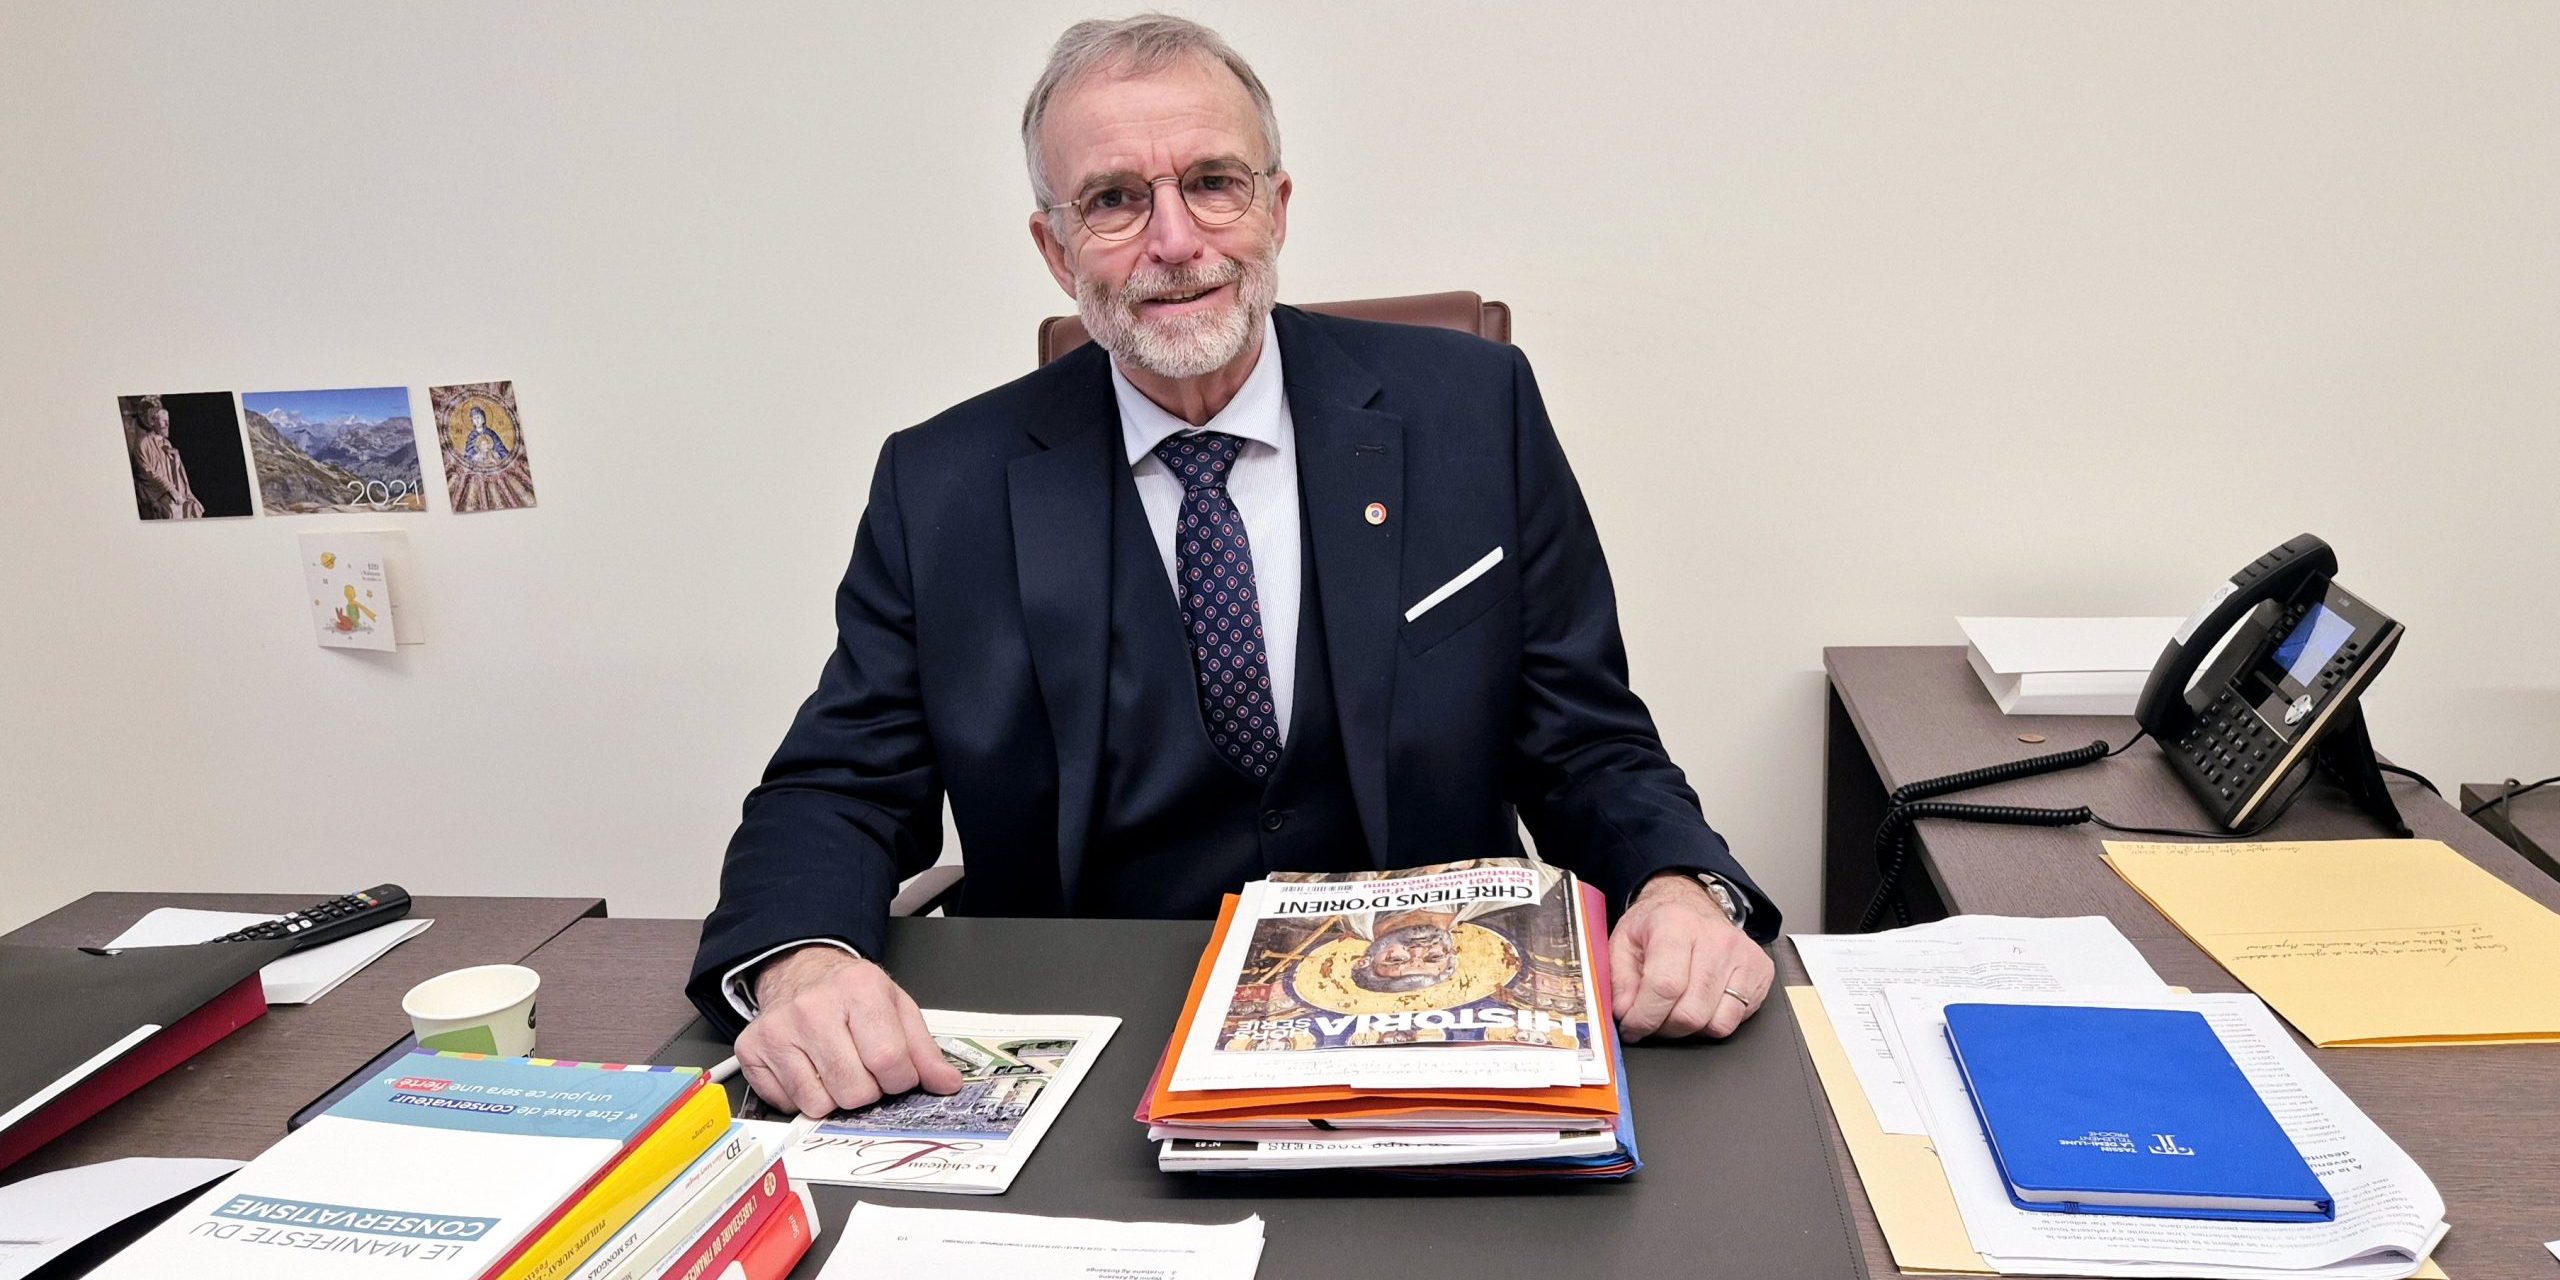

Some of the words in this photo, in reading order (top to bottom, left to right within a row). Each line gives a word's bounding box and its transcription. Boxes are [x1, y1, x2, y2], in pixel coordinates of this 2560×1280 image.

[347, 479, 421, 508] 2021
[1362, 876, 1431, 890] méconnu
[1434, 869, 1534, 884] christianisme
[1508, 875, 1534, 887] Les
[1372, 886, 1405, 896] d'un
[1407, 878, 1463, 892] visages
[1396, 884, 1534, 908] CHRÉTIENS
[1273, 896, 1390, 915] D'ORIENT
[1314, 1008, 1577, 1037] HISTORIA
[399, 1077, 448, 1093] fierté
[447, 1082, 485, 1094] une
[486, 1086, 524, 1098] sera
[524, 1090, 548, 1100] ce
[548, 1090, 589, 1103] jour
[586, 1093, 613, 1104] un
[393, 1093, 515, 1114] conservateur.
[516, 1105, 542, 1117] de
[542, 1107, 582, 1119] taxé
[585, 1109, 624, 1123] Être
[2078, 1135, 2132, 1143] TELLEMENT
[2087, 1130, 2130, 1138] PROCHE
[2058, 1139, 2117, 1148] DEMI-LUNE
[2100, 1146, 2138, 1154] TASSIN
[907, 1161, 972, 1174] château
[974, 1163, 998, 1174] Le
[222, 1198, 487, 1238] CONSERVATISME
[721, 1195, 758, 1247] L'ABÉCÉDAIRE
[189, 1221, 236, 1240] DU
[788, 1213, 801, 1240] Seuil
[232, 1226, 421, 1259] MANIFESTE
[574, 1220, 606, 1253] PHILIPPE
[624, 1231, 639, 1248] LES
[418, 1244, 464, 1262] LE
[711, 1236, 722, 1256] DU
[548, 1247, 574, 1277] MURAY
[586, 1245, 624, 1280] MONGOLS
